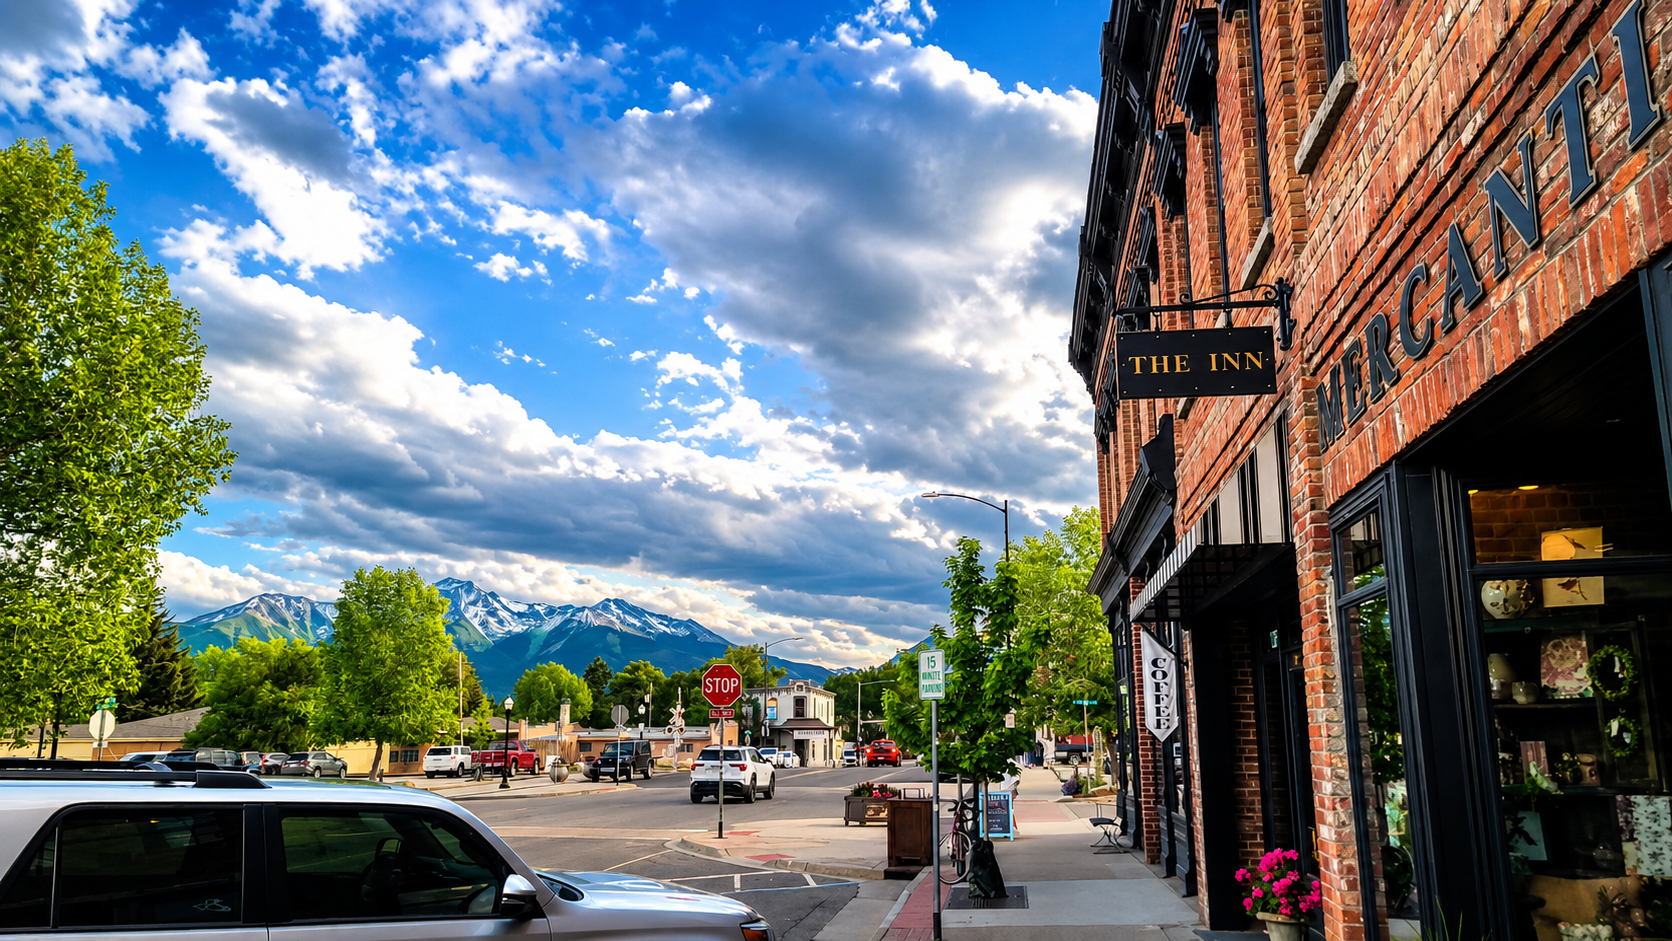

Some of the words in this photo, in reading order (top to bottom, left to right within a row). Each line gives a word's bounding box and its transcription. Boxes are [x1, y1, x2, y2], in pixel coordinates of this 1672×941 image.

[1316, 0, 1661, 452] MERCANTI
[1128, 354, 1190, 375] THE
[1209, 351, 1263, 371] INN
[927, 656, 936, 669] 15
[705, 678, 739, 693] STOP
[1151, 657, 1170, 730] COFFEE
